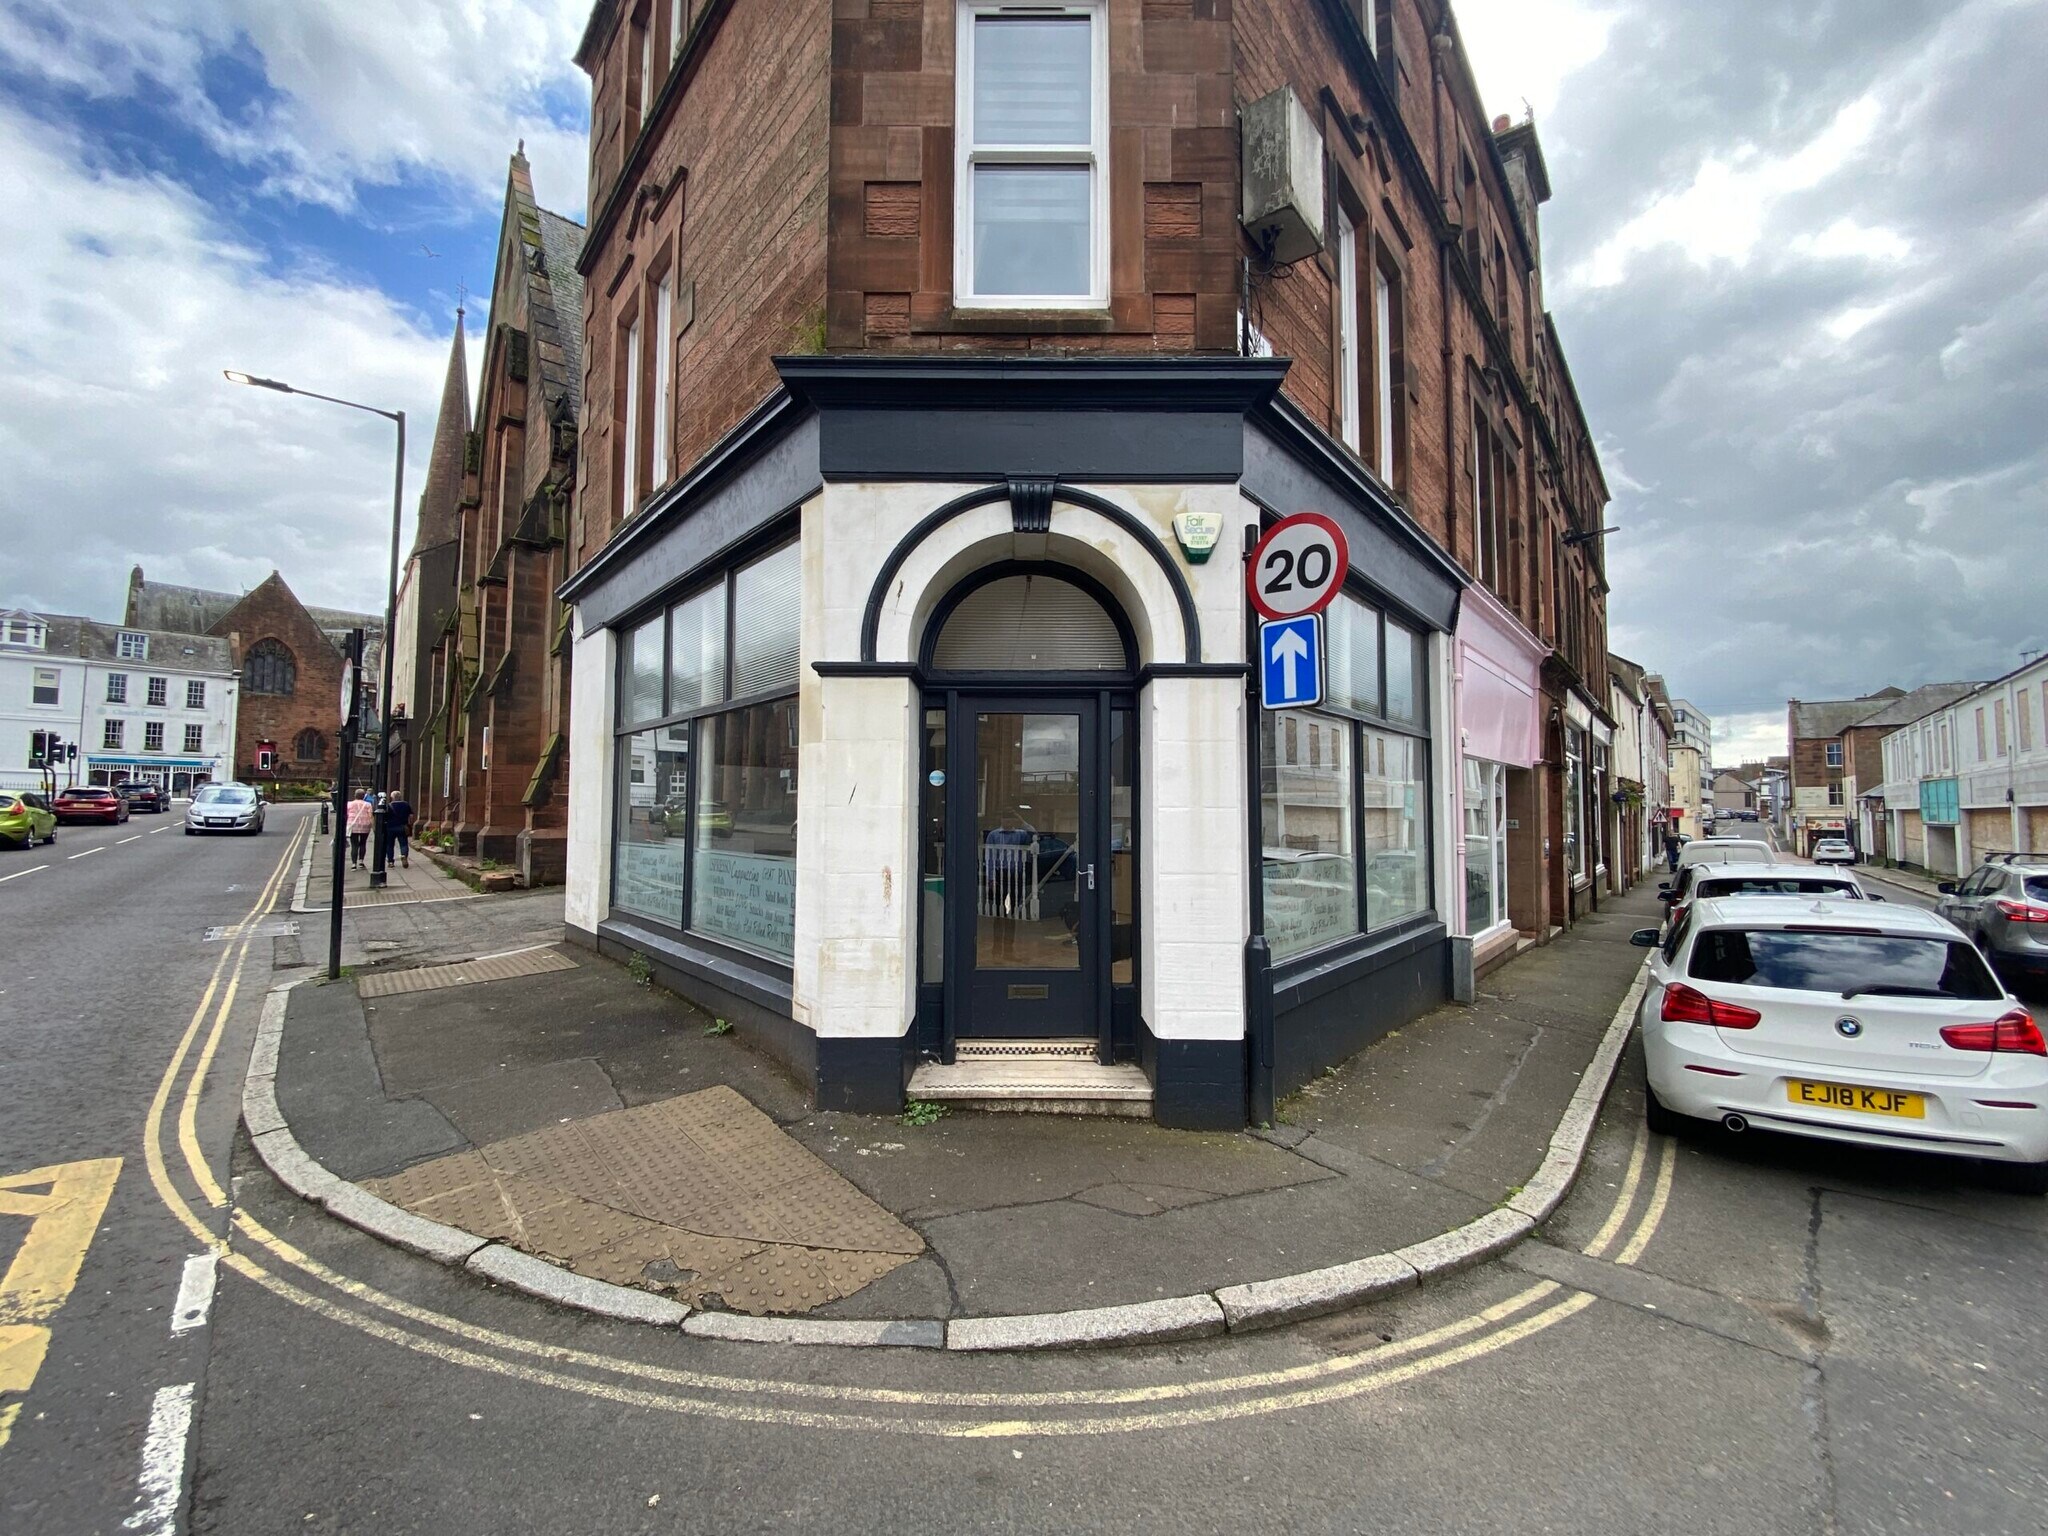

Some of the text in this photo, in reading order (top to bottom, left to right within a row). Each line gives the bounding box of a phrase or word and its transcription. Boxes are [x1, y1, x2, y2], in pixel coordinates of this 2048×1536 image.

[1184, 525, 1216, 535] Secure
[1186, 515, 1205, 527] Fair
[1264, 543, 1332, 595] 20
[1800, 1083, 1907, 1112] EJ18 KJF
